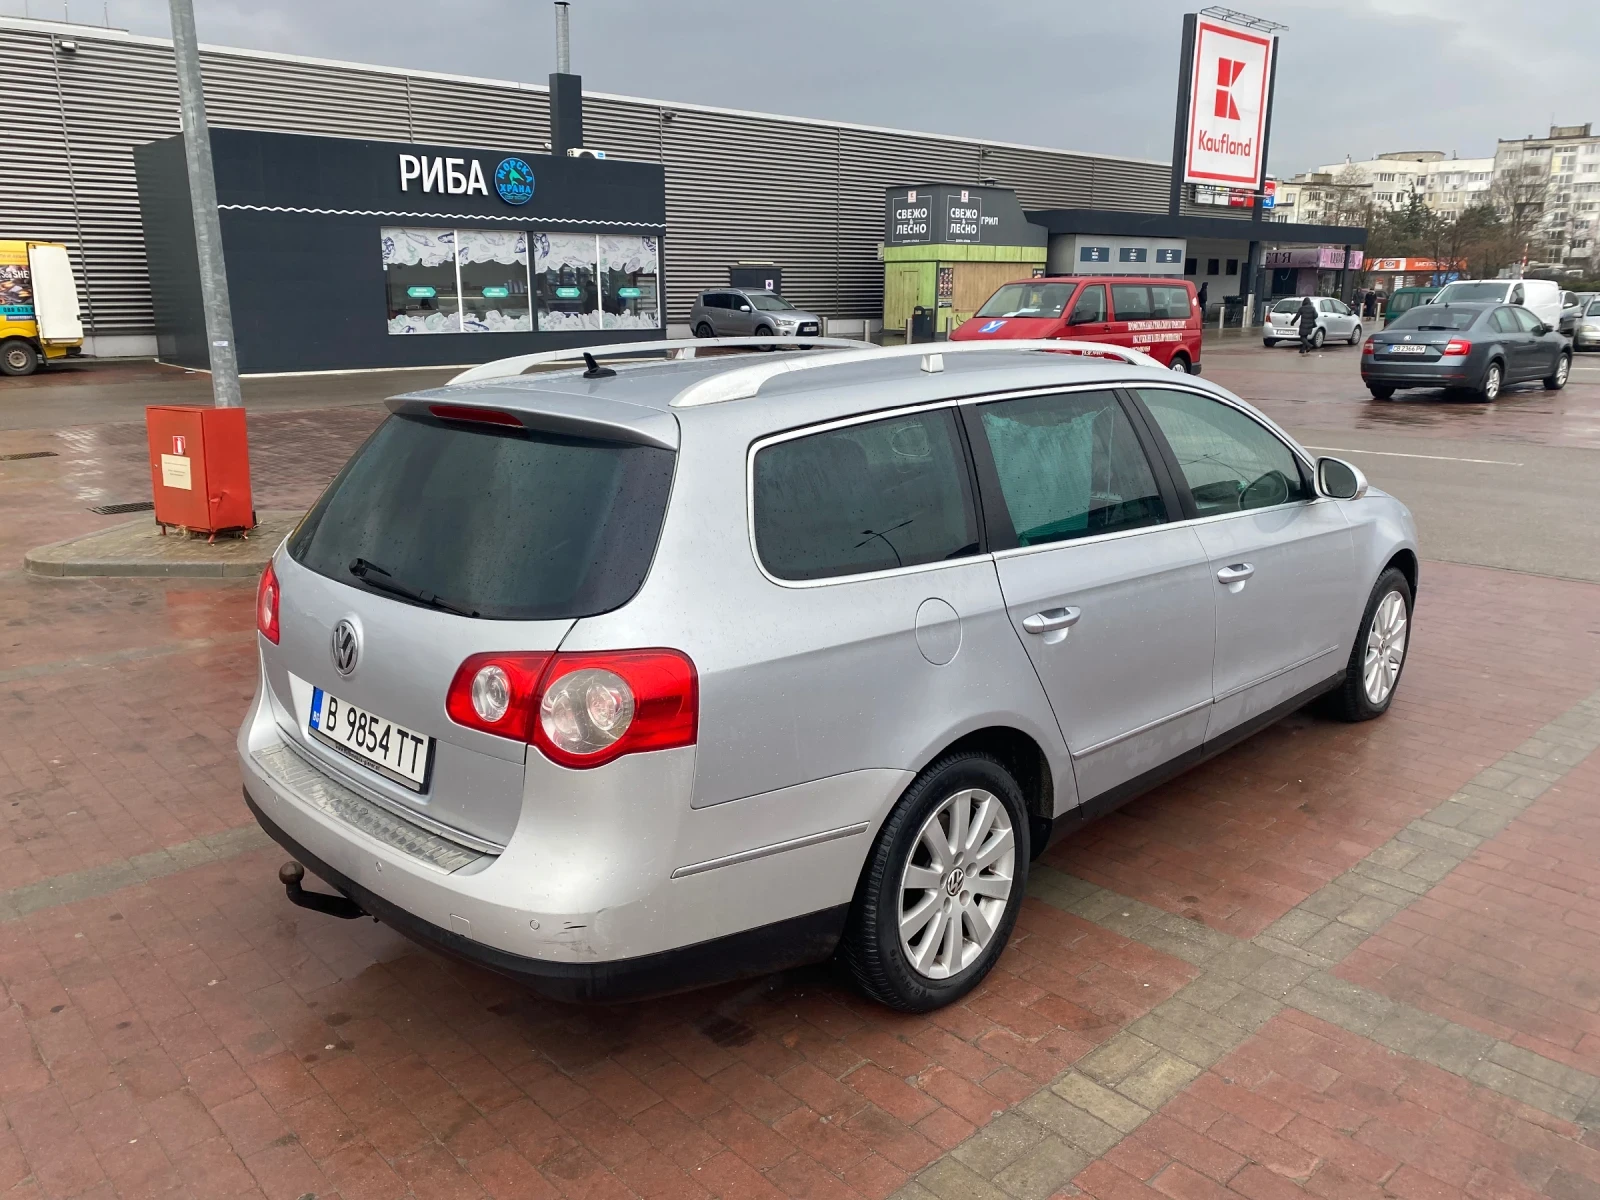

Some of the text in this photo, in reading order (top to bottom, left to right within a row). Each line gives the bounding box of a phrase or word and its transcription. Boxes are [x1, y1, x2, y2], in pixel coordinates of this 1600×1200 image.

[1198, 129, 1252, 157] Kaufland
[399, 153, 489, 196] РИБА
[497, 159, 533, 183] МОРСКА
[499, 183, 532, 194] ХРАНА
[896, 207, 928, 219] СВЕЖО
[950, 207, 978, 219] СВЕЖО
[980, 216, 999, 226] ГРИЛ
[896, 223, 927, 235] ЛЕСНО
[950, 223, 977, 235] ЛЕСНО
[13, 270, 30, 279] SHE
[326, 696, 338, 732] B
[346, 707, 392, 761] 9854
[397, 728, 424, 774] TT
